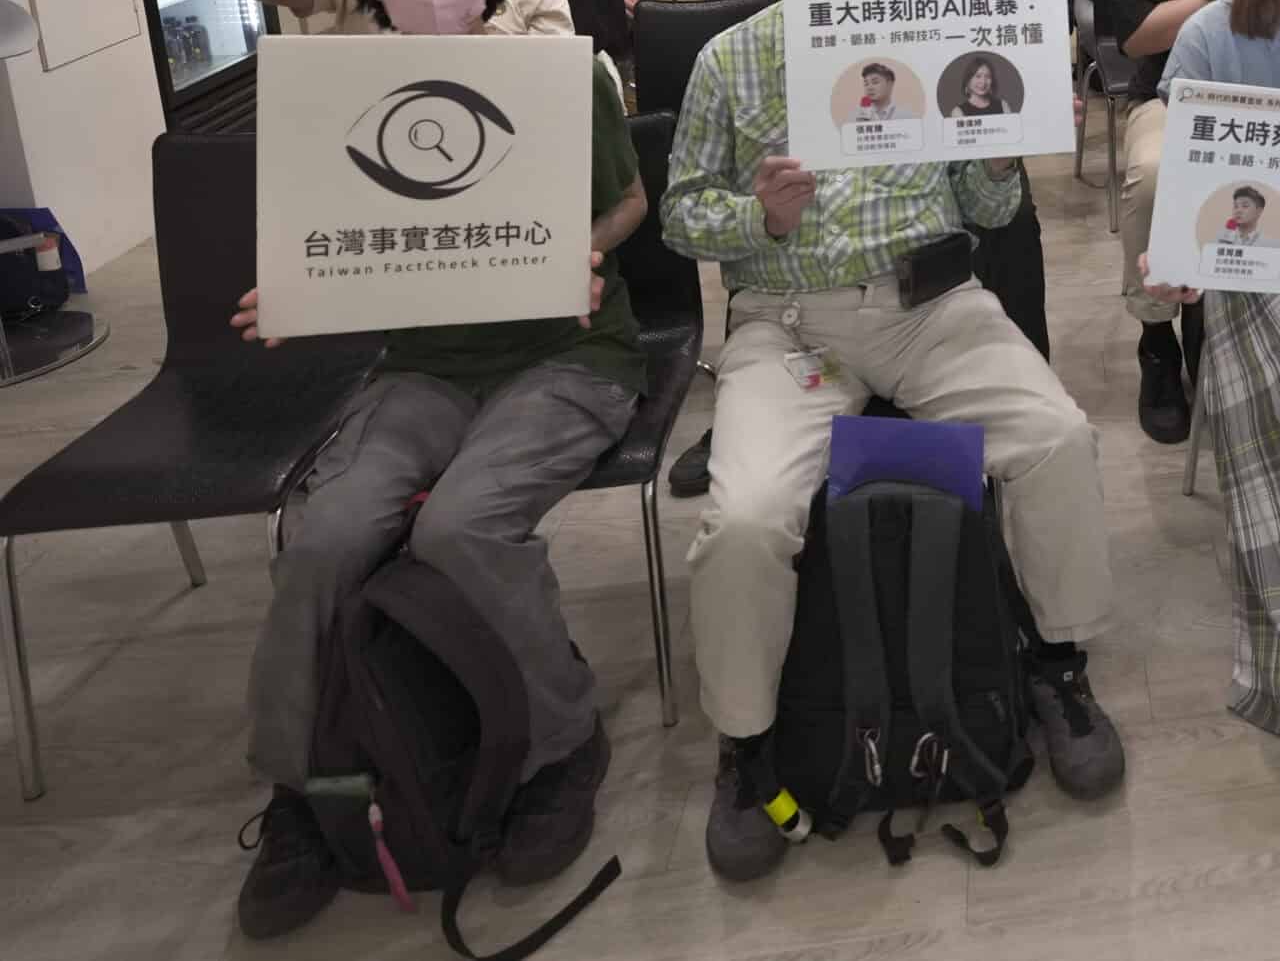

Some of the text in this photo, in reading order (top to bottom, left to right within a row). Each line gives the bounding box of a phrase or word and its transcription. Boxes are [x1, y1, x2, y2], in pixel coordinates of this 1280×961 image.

[304, 221, 552, 258] 台灣事實查核中心
[306, 254, 550, 280] Taiwan FactCheck Center
